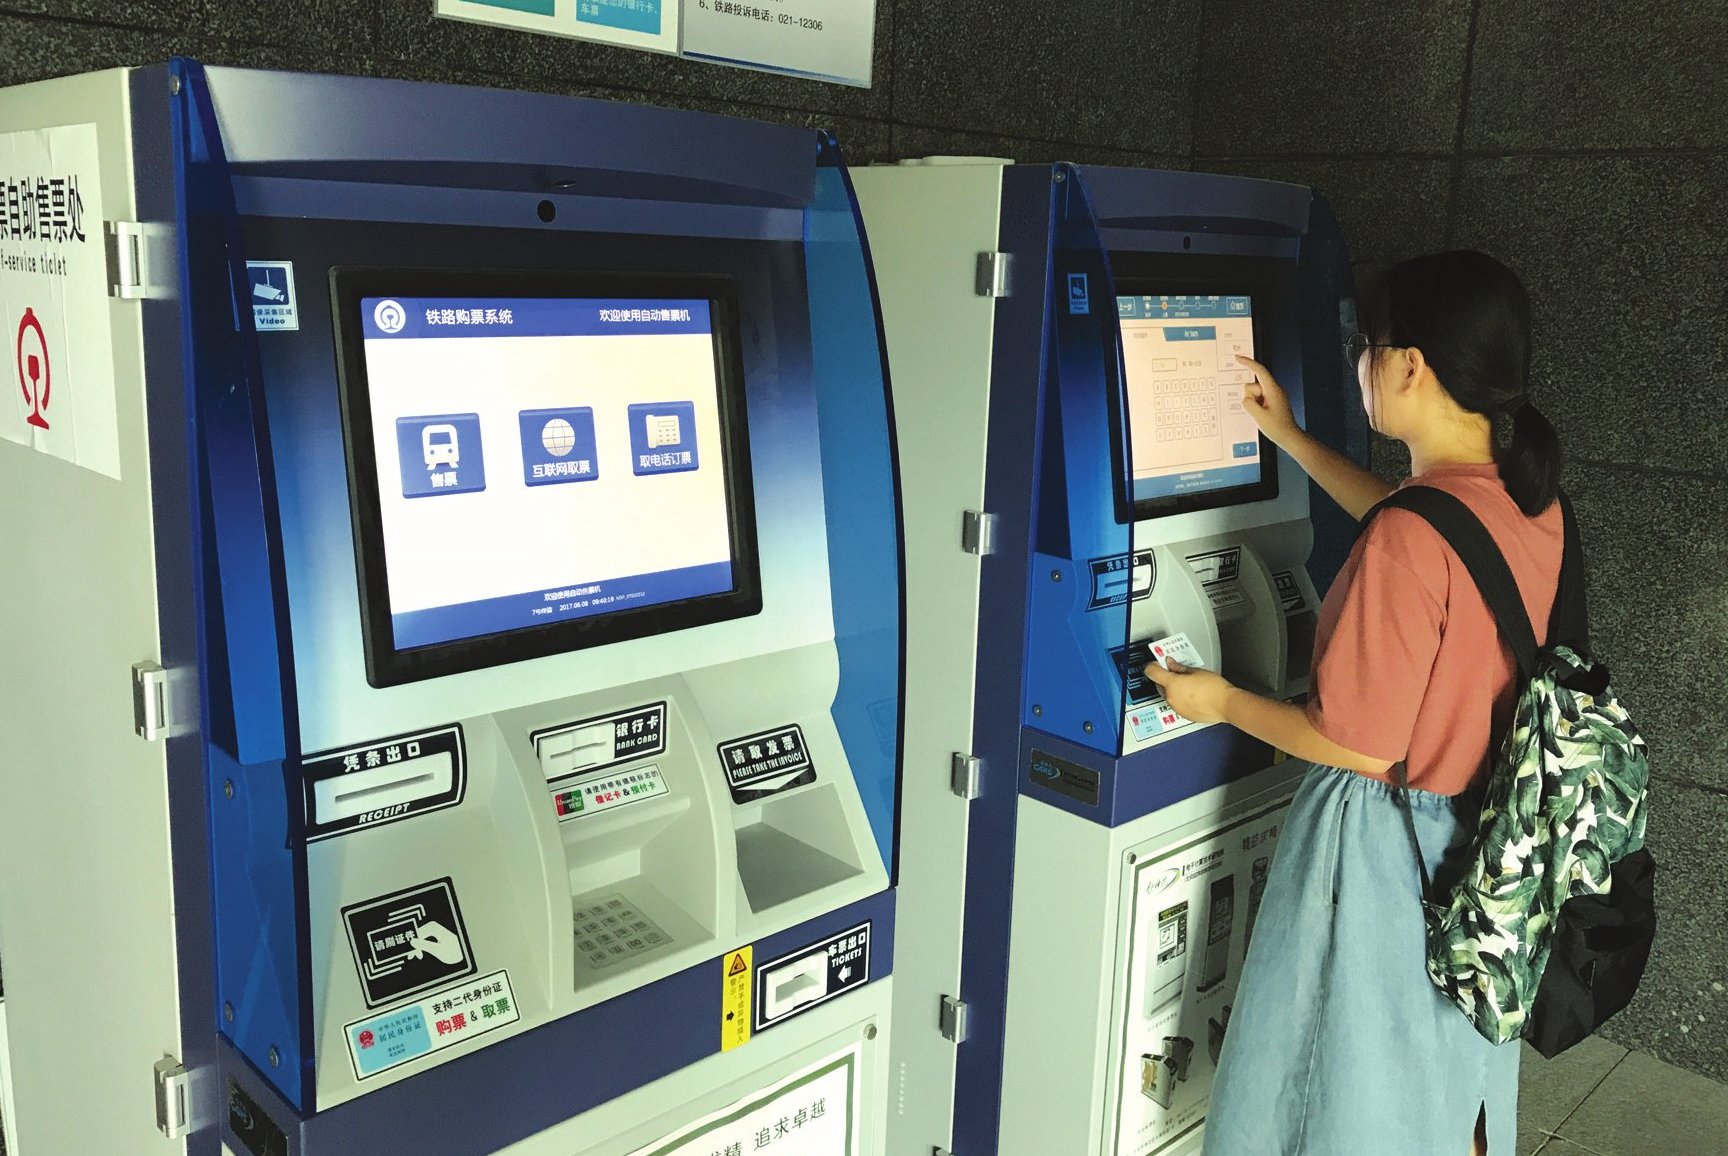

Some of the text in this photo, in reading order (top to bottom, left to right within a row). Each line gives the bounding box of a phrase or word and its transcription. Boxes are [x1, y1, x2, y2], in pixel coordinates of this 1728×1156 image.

[425, 308, 690, 326] 铁路购票系统 欢迎使用自动售票机
[532, 459, 591, 478] 互联网取票
[639, 451, 692, 468] 取电话订票
[430, 472, 458, 488] 售票
[616, 715, 659, 738] 银行卡
[616, 733, 658, 751] BANK CARD
[731, 735, 795, 764] 请取发票
[343, 741, 421, 772] 凭条出口
[732, 751, 803, 779] PLEASE TAKE THE INVOICE
[585, 770, 659, 794] 请使用带有银联标志的
[595, 781, 656, 804] 借记卡 & 预付卡
[358, 803, 411, 824] RECEIPT
[374, 930, 416, 952] 请刷证件
[828, 931, 866, 957] 车票出口
[831, 947, 862, 968] TICKETS
[432, 981, 503, 1015] 支持二代身份证
[435, 997, 511, 1037] 购票 & 取票
[379, 1022, 422, 1043] 居民身份证
[754, 1098, 826, 1151] 追求卓越
